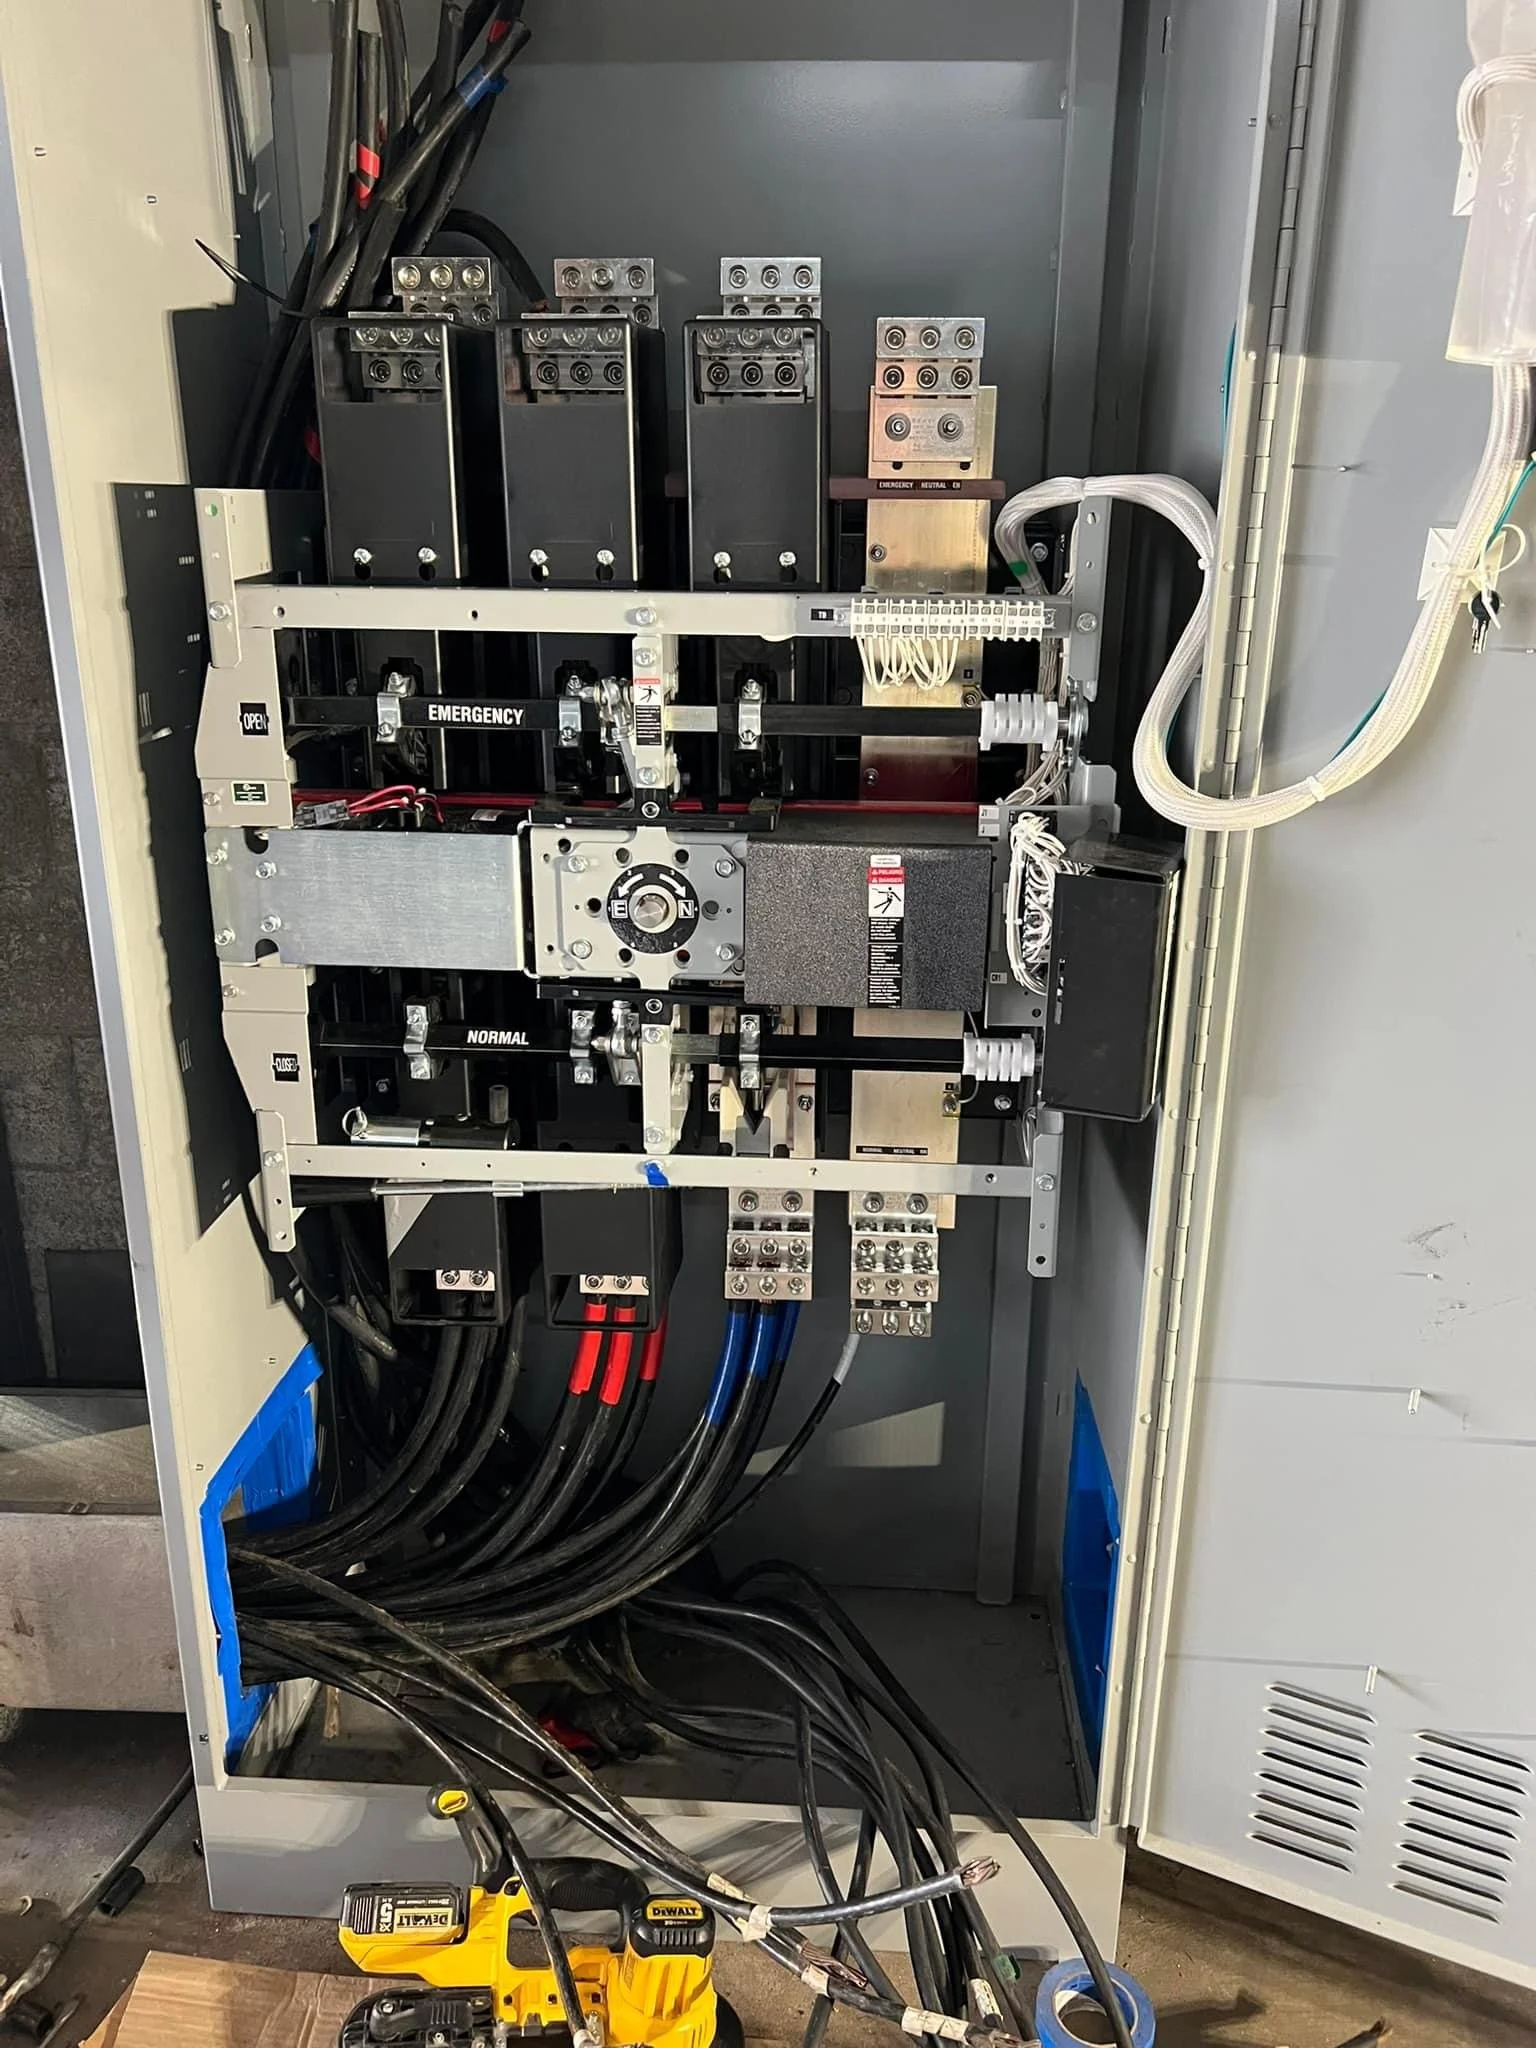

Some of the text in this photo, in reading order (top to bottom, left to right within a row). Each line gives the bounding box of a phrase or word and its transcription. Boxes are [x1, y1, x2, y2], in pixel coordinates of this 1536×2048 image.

[879, 481, 914, 489] EMERGENCY
[920, 481, 947, 489] NEUTRAL
[243, 713, 267, 730] OPEN
[428, 704, 524, 726] EMERGENCY
[614, 901, 626, 917] E
[680, 901, 692, 917] N
[466, 1029, 529, 1046] NORMAL
[380, 1902, 393, 1923] 5
